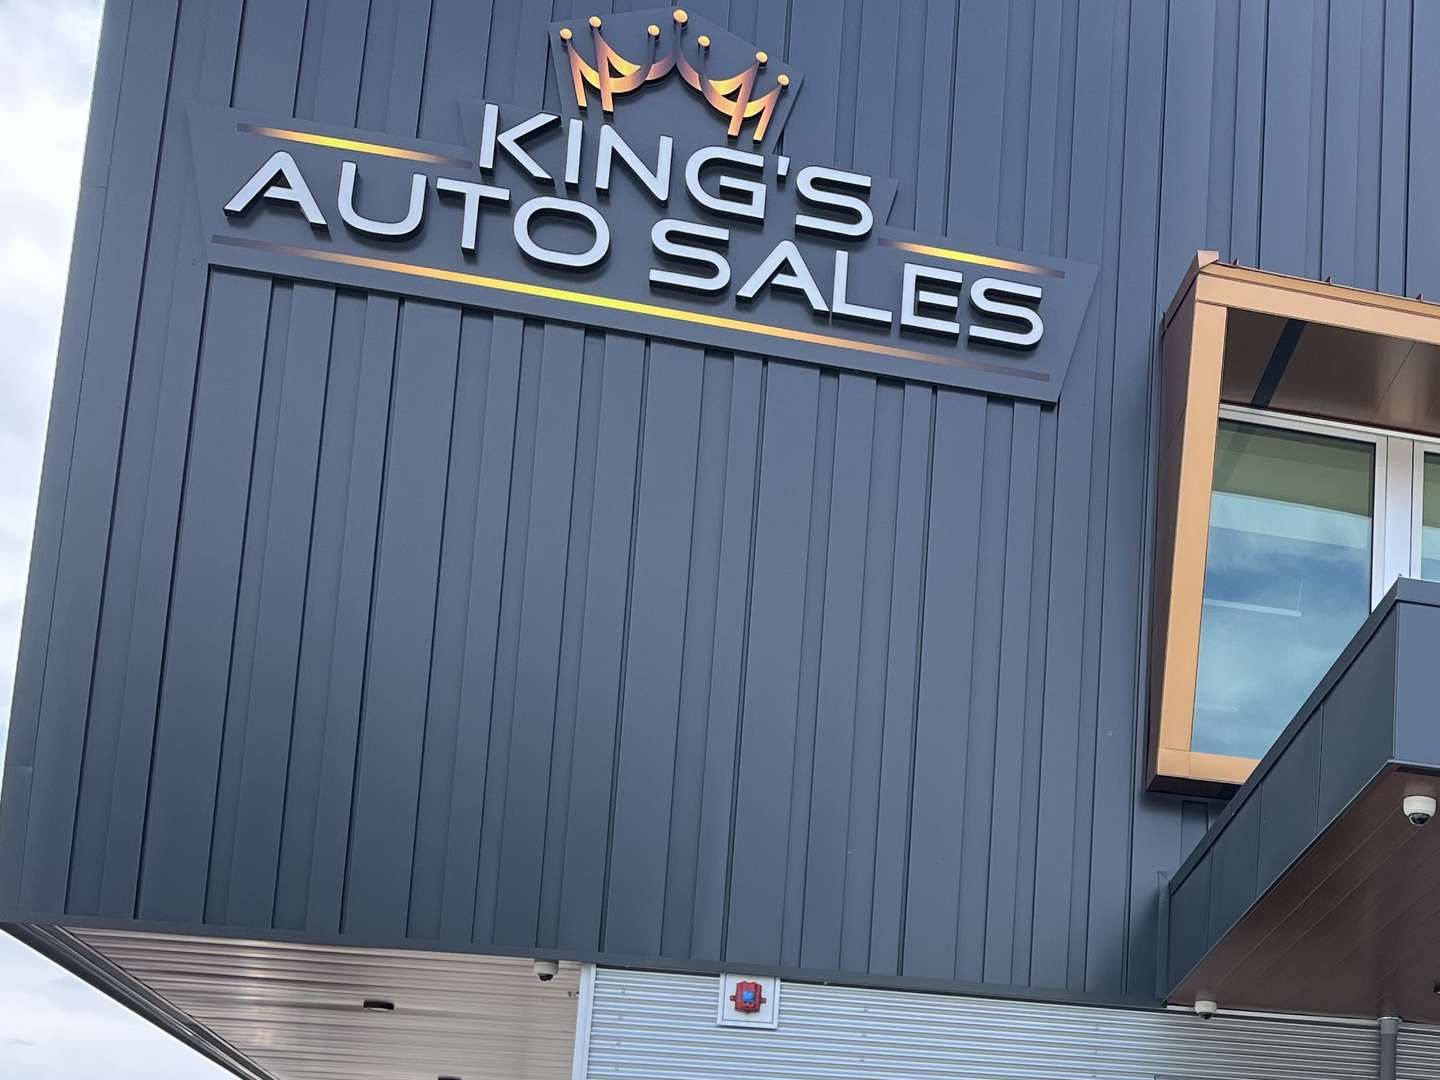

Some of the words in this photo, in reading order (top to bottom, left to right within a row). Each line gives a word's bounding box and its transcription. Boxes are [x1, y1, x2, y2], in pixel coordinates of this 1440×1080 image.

[223, 149, 611, 272] AUTO
[648, 218, 1044, 350] SALES
[479, 102, 874, 239] KING'S
